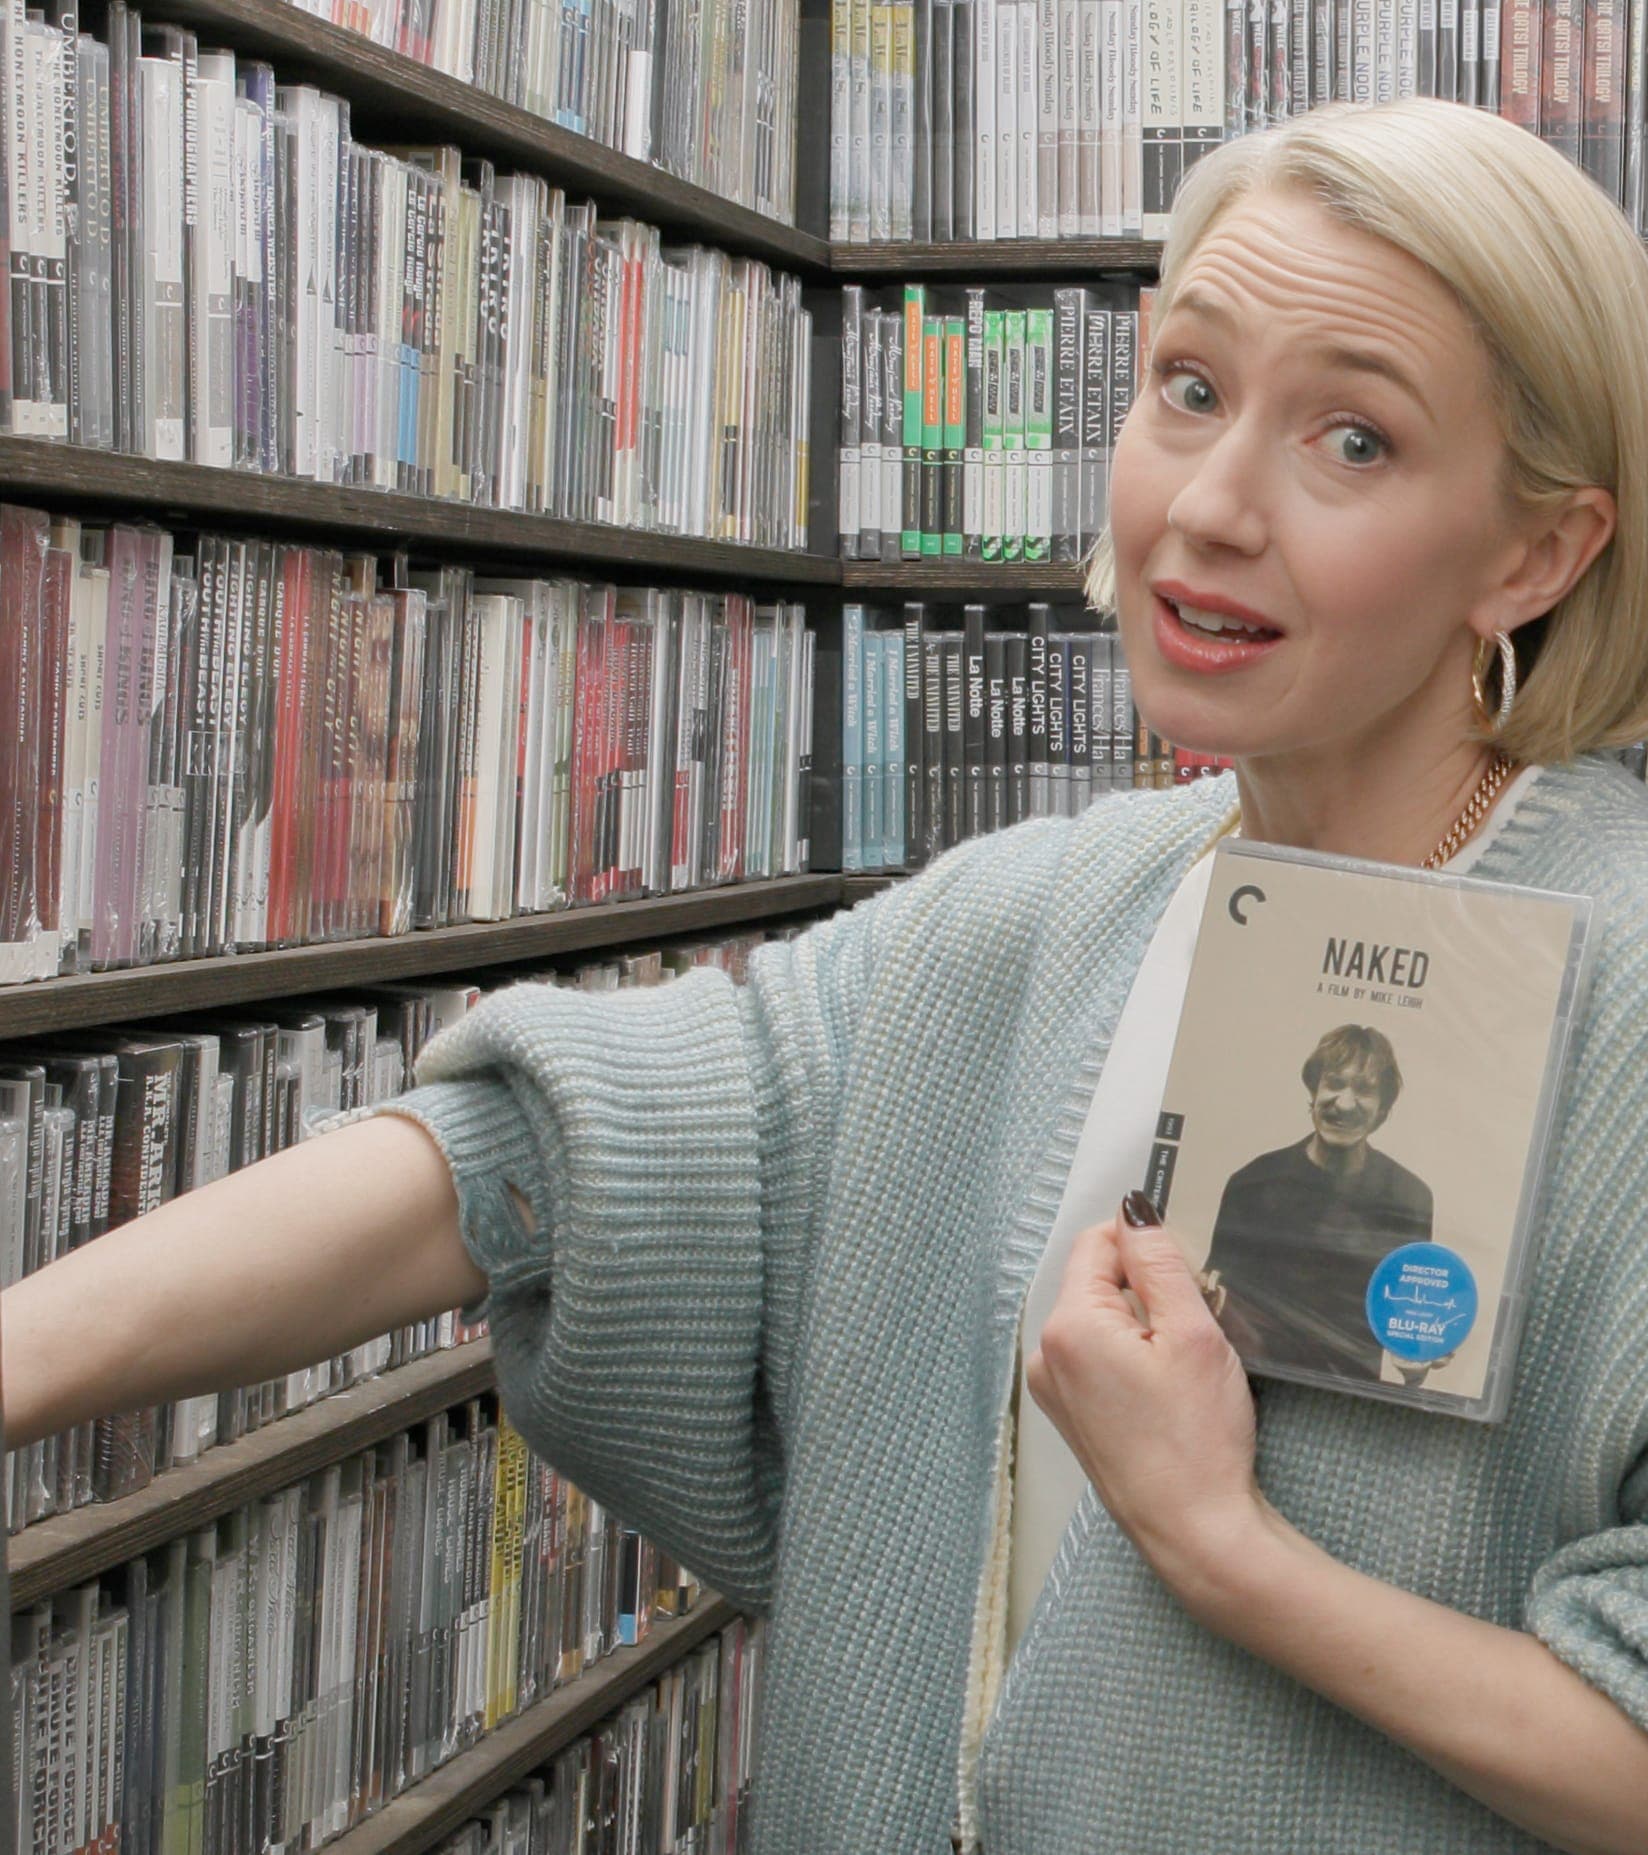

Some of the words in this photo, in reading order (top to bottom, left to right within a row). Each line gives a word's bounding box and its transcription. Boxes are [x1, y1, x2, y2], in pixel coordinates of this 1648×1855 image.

[1106, 11, 1117, 47] Sunday
[1512, 11, 1528, 44] QATSI
[1595, 19, 1611, 52] QATSI
[1106, 50, 1117, 83] Bloody
[1191, 59, 1201, 76] OF
[1513, 48, 1529, 94] TRILOGY
[1595, 56, 1611, 102] TRILOGY
[15, 38, 26, 144] HONEYMOON
[1106, 86, 1117, 120] Sunday
[1192, 83, 1202, 112] LIFE
[99, 85, 110, 216] UMBERTO
[185, 92, 197, 225] PORNOGRAPHERS
[17, 152, 27, 225] KILLERS
[100, 225, 110, 250] D.
[414, 262, 425, 300] Rouge
[968, 301, 982, 333] REPO
[968, 337, 982, 368] MAN
[1059, 305, 1074, 370] PIERRE
[1114, 315, 1130, 379] PIERRE
[1058, 378, 1075, 434] ETAIX
[201, 561, 211, 632] YOUTH
[227, 561, 239, 655] FIGHTING
[274, 582, 284, 638] CASQUE
[156, 604, 168, 690] KAGEMUSHA
[272, 647, 282, 678] D'OR
[947, 654, 959, 675] THE
[888, 656, 899, 706] Married
[991, 679, 1003, 696] La
[1012, 677, 1026, 694] La
[1049, 653, 1062, 690] CITY
[1072, 655, 1085, 692] CITY
[196, 657, 208, 725] BEAST
[224, 663, 235, 729] ELEGY
[888, 718, 899, 751] Witch
[991, 700, 1004, 738] Notte
[1012, 697, 1026, 735] Notte
[1050, 697, 1062, 751] LIGHTS
[1073, 700, 1086, 753] LIGHTS
[1322, 937, 1430, 988] NAKED
[1316, 982, 1323, 993] A
[1328, 984, 1350, 997] FILM
[1353, 988, 1366, 1000] BY
[1370, 990, 1393, 1005] MIKE
[1397, 995, 1424, 1009] LEIGH
[151, 1072, 167, 1138] MR.
[1399, 1275, 1449, 1288] APPROVED
[1402, 1264, 1449, 1277] DIRECTOR
[1387, 1330, 1415, 1340] SPECIAL
[1416, 1334, 1444, 1344] EDITION
[1389, 1317, 1446, 1336] BLU-RAY
[65, 1657, 77, 1747] BRUTE
[101, 1650, 110, 1748] VENGEANCE
[101, 1755, 108, 1771] IS
[64, 1755, 75, 1844] FORCE
